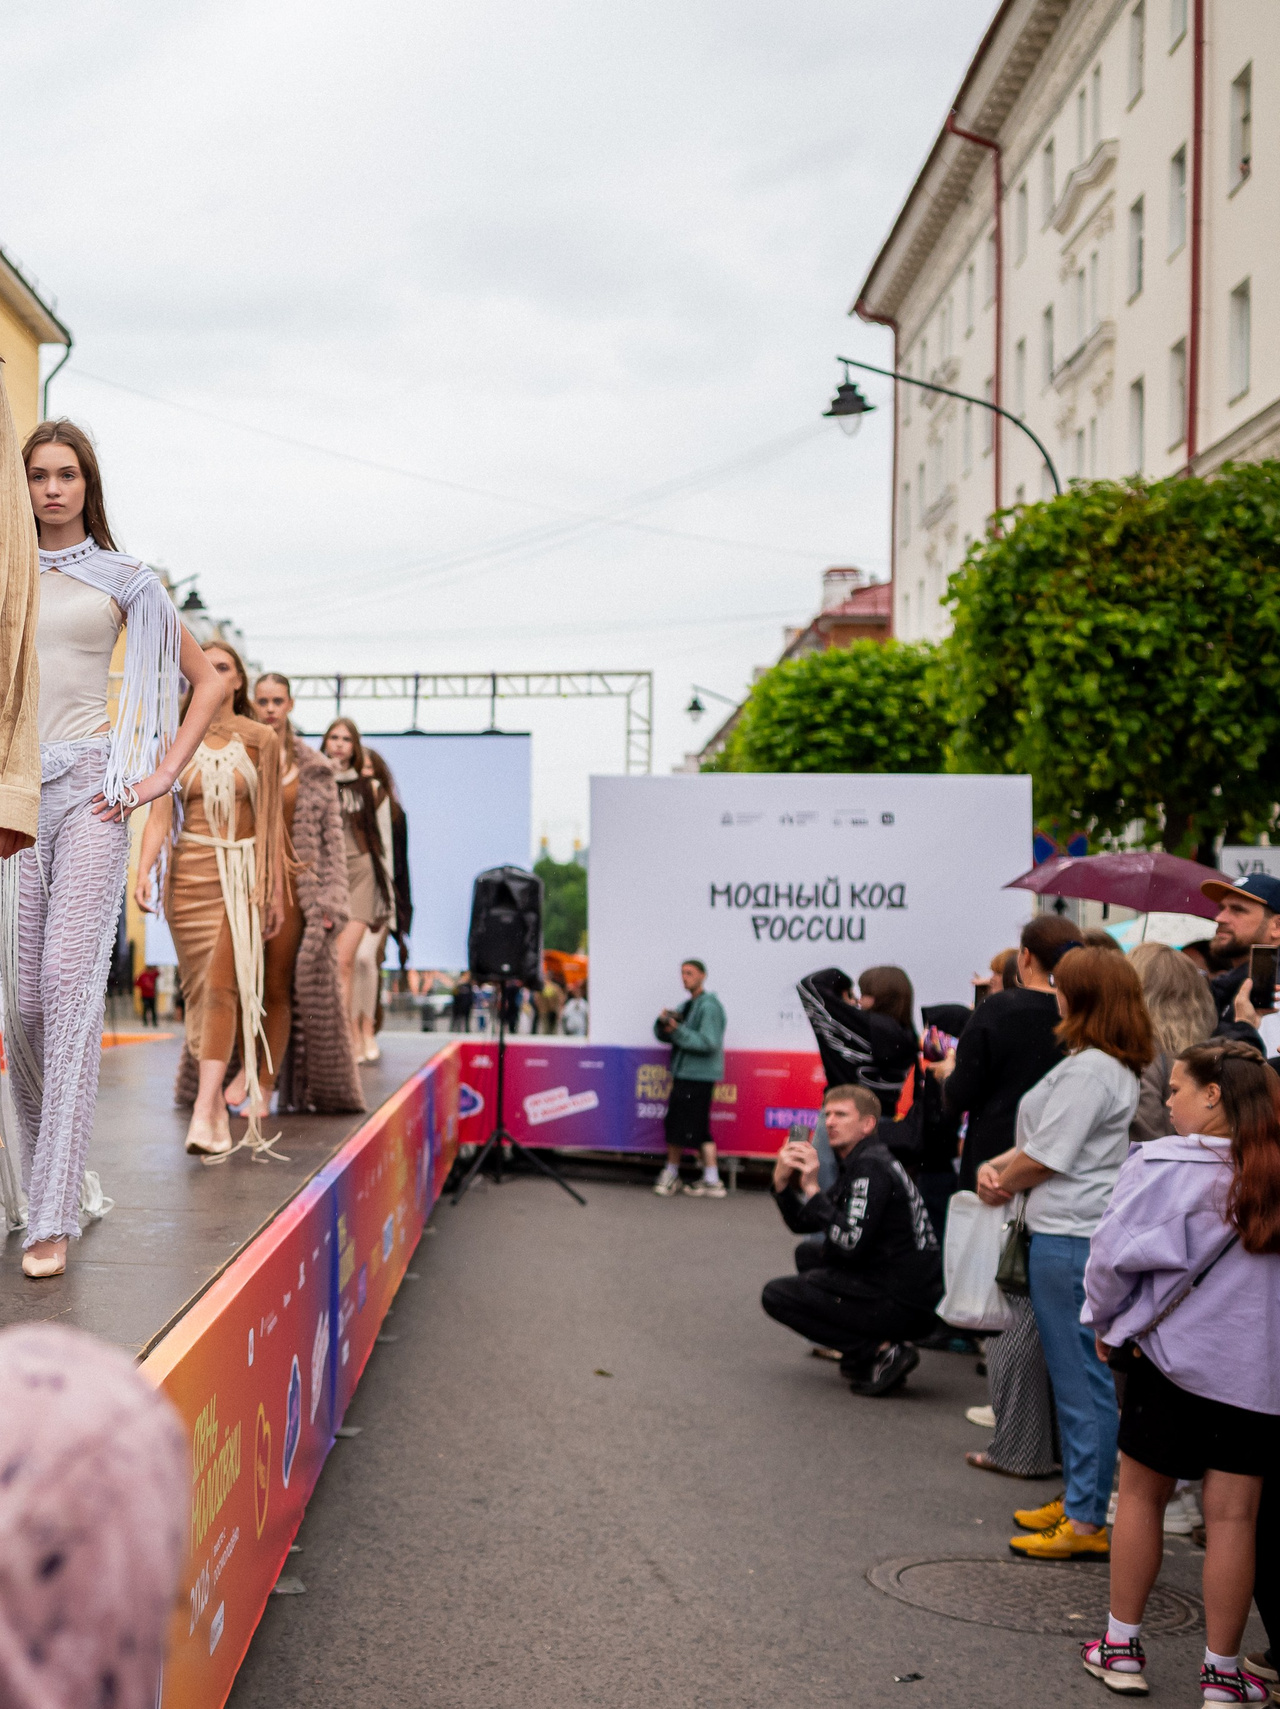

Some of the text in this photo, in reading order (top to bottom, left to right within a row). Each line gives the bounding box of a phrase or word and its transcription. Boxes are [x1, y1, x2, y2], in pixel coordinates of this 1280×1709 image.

[710, 876, 908, 910] МОДНЫЙ КОД
[751, 914, 867, 942] РОССИИ
